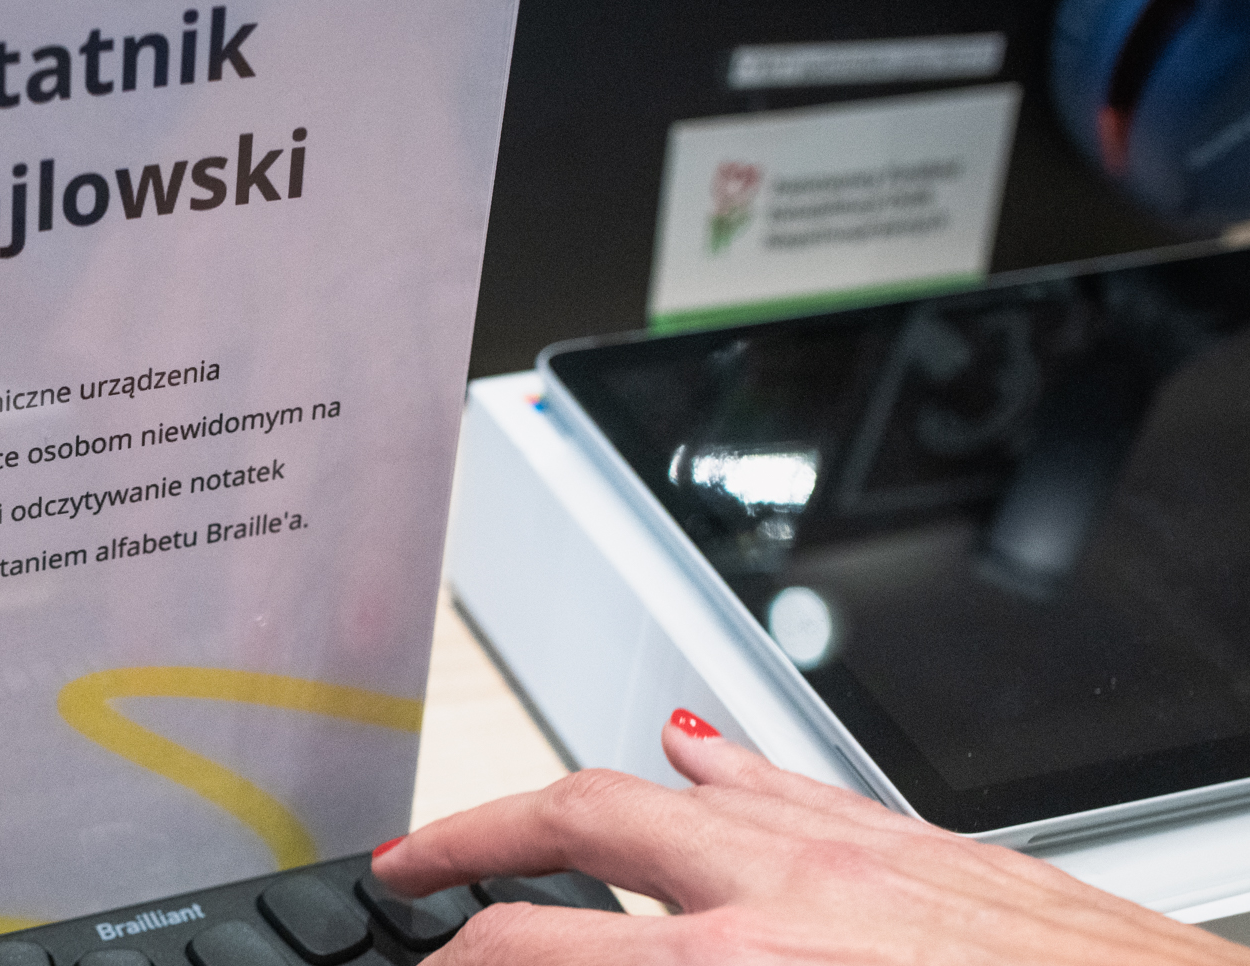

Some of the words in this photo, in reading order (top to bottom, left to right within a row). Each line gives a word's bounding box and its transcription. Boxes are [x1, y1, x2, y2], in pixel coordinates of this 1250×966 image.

[80, 360, 221, 399] urządzenia
[28, 432, 132, 465] osobom
[141, 407, 303, 447] niewidomym
[312, 400, 342, 420] na
[11, 477, 182, 522] odczytywanie
[190, 459, 286, 494] notatek
[95, 531, 198, 562] alfabetu
[206, 511, 309, 544] Braille'a.
[95, 902, 206, 941] Brailliant
